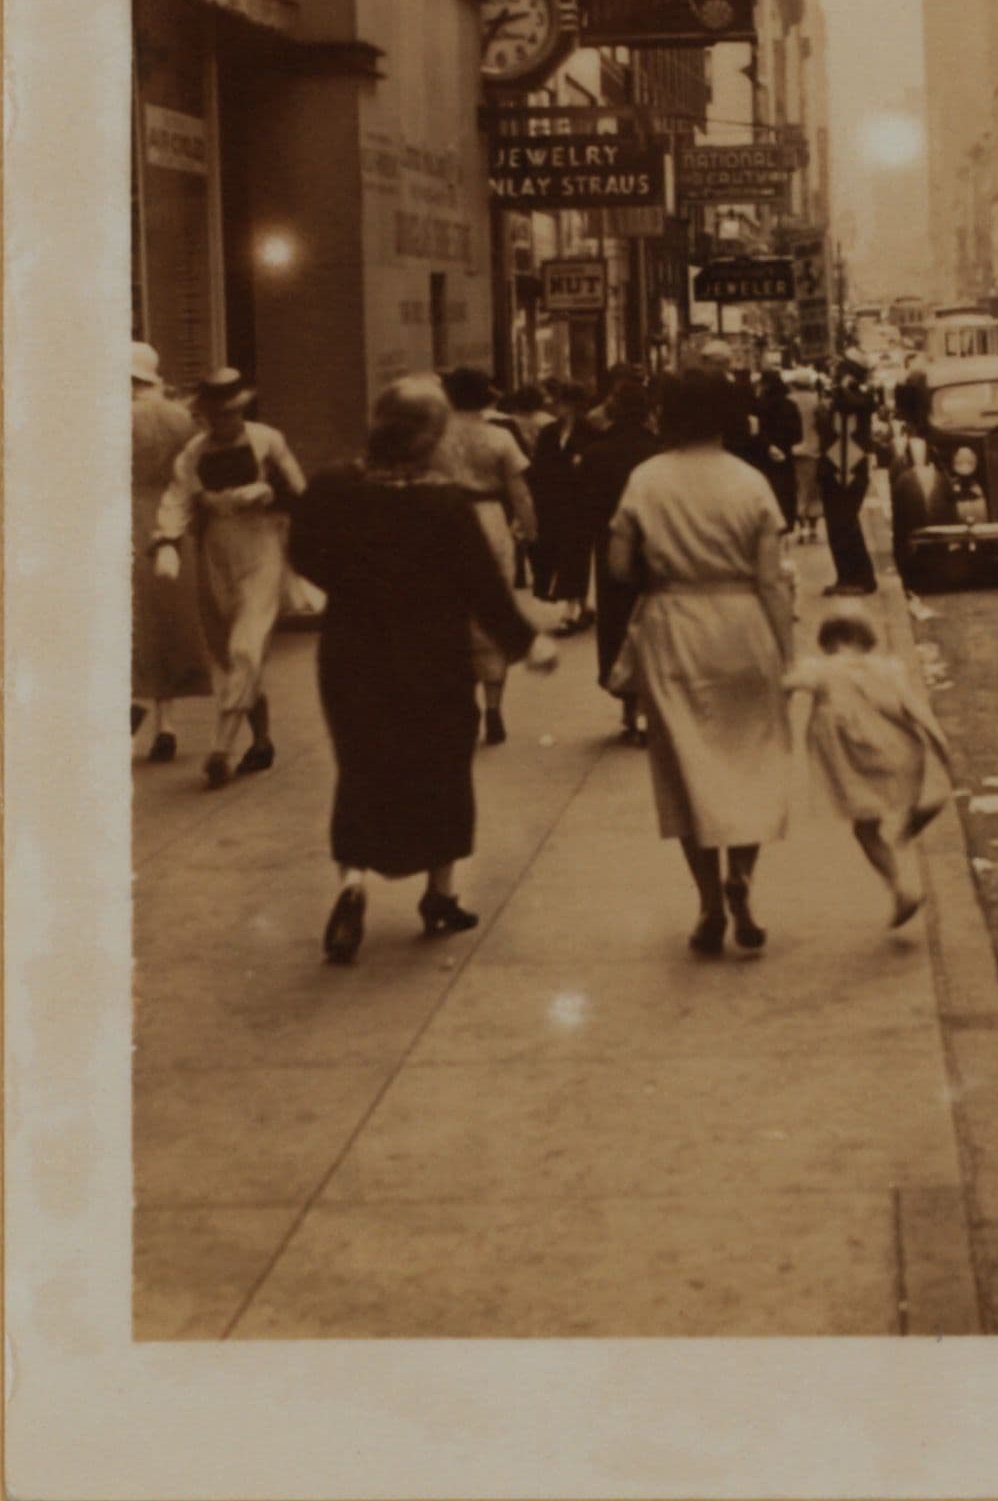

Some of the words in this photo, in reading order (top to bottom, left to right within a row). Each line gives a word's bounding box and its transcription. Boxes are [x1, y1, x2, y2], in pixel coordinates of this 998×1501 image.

[496, 146, 619, 169] JEWELRY
[561, 172, 650, 196] STRAUS
[704, 279, 787, 297] JEWELER
